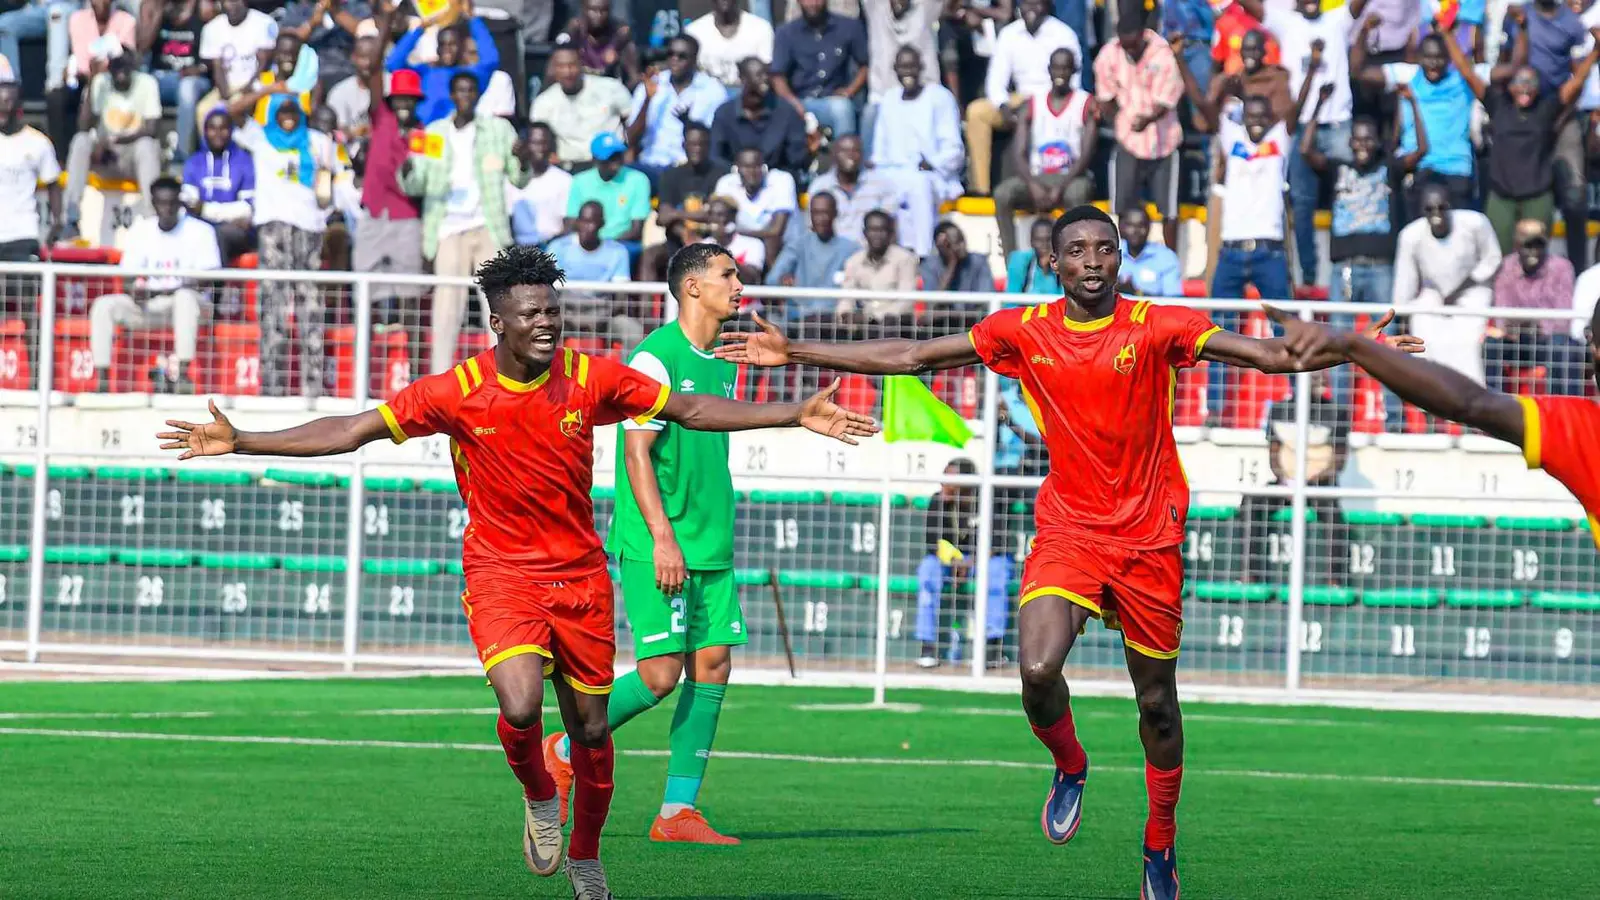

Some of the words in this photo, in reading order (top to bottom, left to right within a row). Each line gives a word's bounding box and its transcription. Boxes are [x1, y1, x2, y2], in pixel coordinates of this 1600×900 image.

[71, 349, 94, 380] 29
[1041, 357, 1055, 366] STC
[484, 427, 497, 435] STC
[747, 445, 767, 471] 20
[1481, 471, 1498, 493] 11
[120, 494, 144, 525] 27
[200, 498, 225, 530] 26
[278, 500, 303, 531] 25
[364, 504, 389, 536] 24
[851, 521, 877, 554] 18
[1269, 533, 1294, 564] 13
[1350, 544, 1375, 574] 12
[1432, 546, 1455, 576] 11
[1513, 549, 1540, 582] 10
[59, 574, 83, 606] 27
[137, 575, 164, 607] 26
[222, 582, 248, 613] 25
[304, 583, 330, 614] 24
[388, 585, 414, 616] 23
[804, 601, 828, 632] 18
[1218, 614, 1243, 646] 13
[487, 643, 499, 654] STC
[1301, 620, 1323, 653] 12
[1391, 624, 1415, 656] 11
[1464, 626, 1491, 659] 10
[1555, 627, 1574, 659] 9
